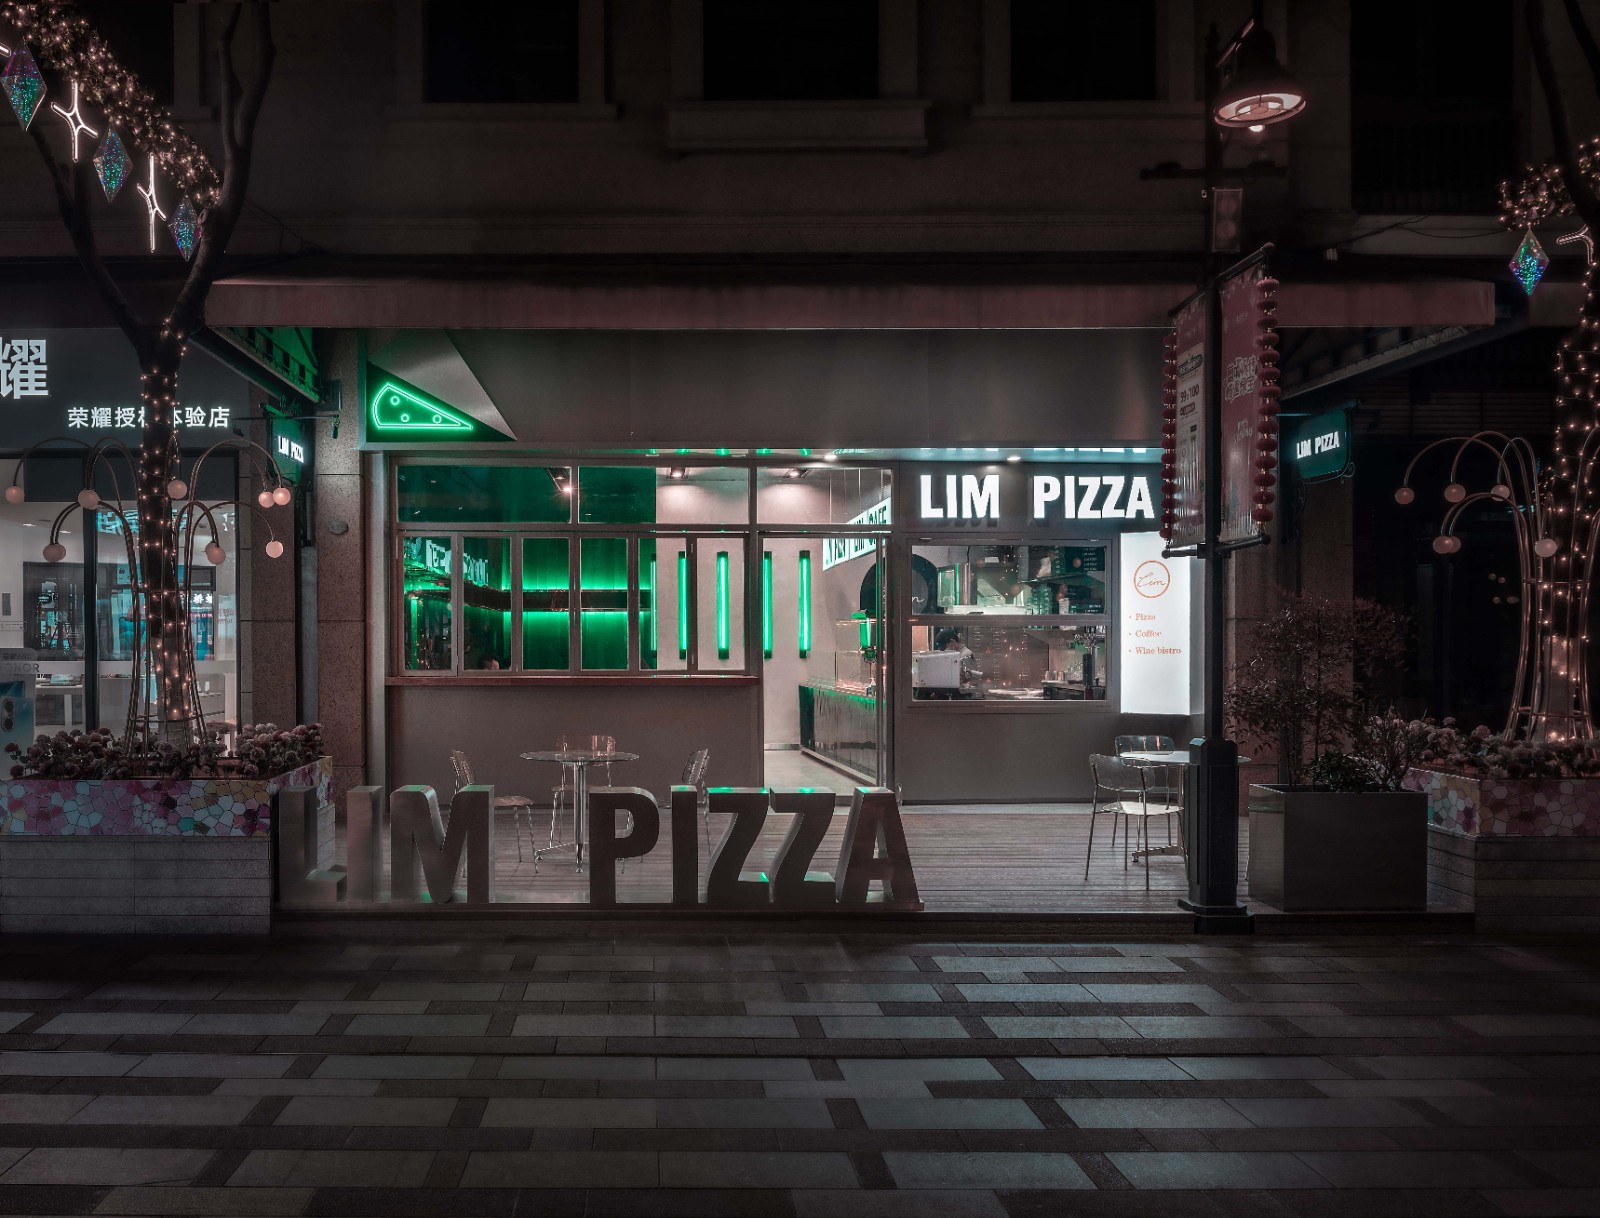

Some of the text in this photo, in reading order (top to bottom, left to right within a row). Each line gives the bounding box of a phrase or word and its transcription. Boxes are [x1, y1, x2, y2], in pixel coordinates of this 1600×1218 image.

[278, 435, 289, 456] LIM
[1296, 431, 1340, 459] LIM PIZZA
[919, 474, 1155, 519] LIM PIZZA
[1135, 613, 1156, 621] Pizza
[1135, 630, 1162, 638] Coffee
[1135, 646, 1182, 655] Wine bistro
[278, 784, 924, 905] LIM PIZZA
